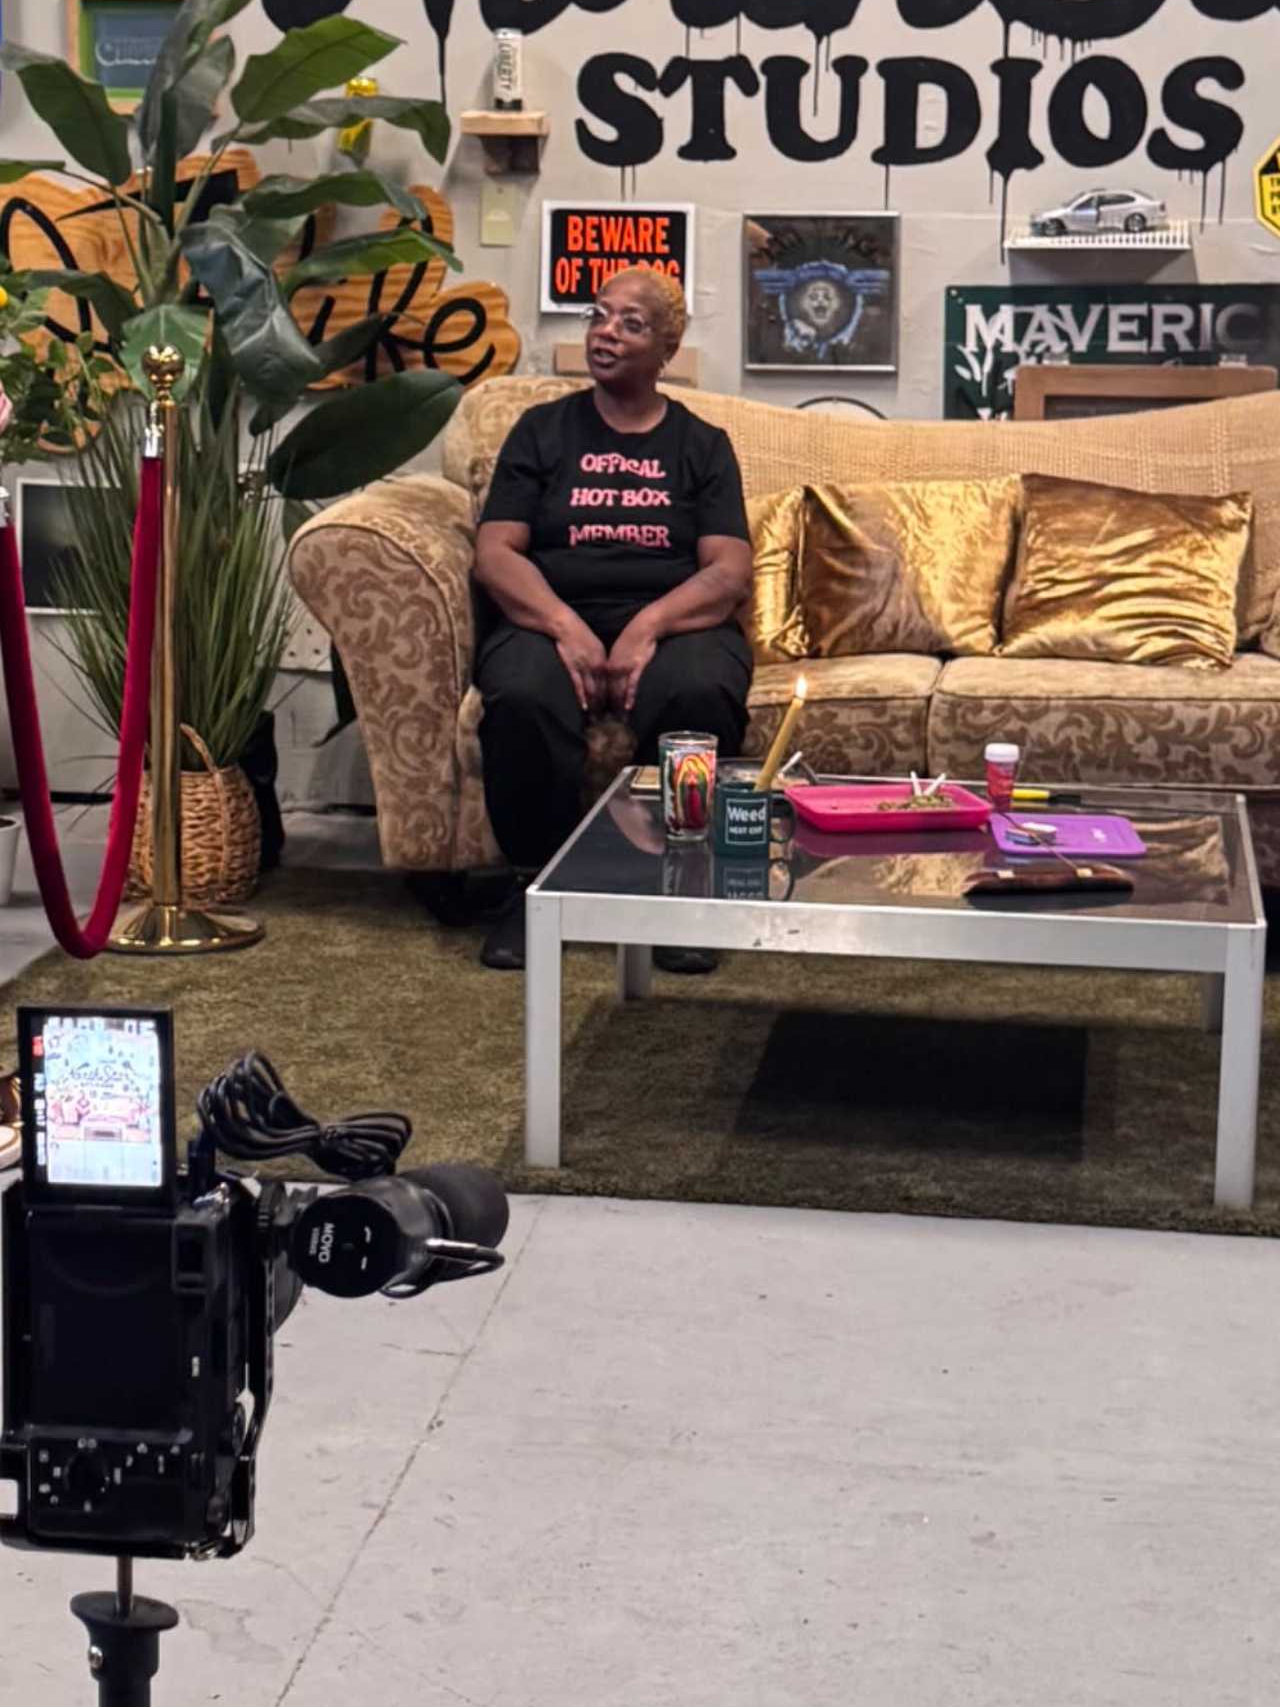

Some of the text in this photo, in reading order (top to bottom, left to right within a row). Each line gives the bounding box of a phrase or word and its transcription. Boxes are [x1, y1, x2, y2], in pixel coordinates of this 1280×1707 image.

[575, 49, 1245, 172] STUDIOS
[566, 214, 671, 254] BEWARE
[554, 256, 584, 294] OF
[570, 487, 671, 507] HOT BOX
[568, 524, 671, 549] MEMBER
[727, 806, 767, 822] Weed
[317, 1222, 335, 1264] MOVO
